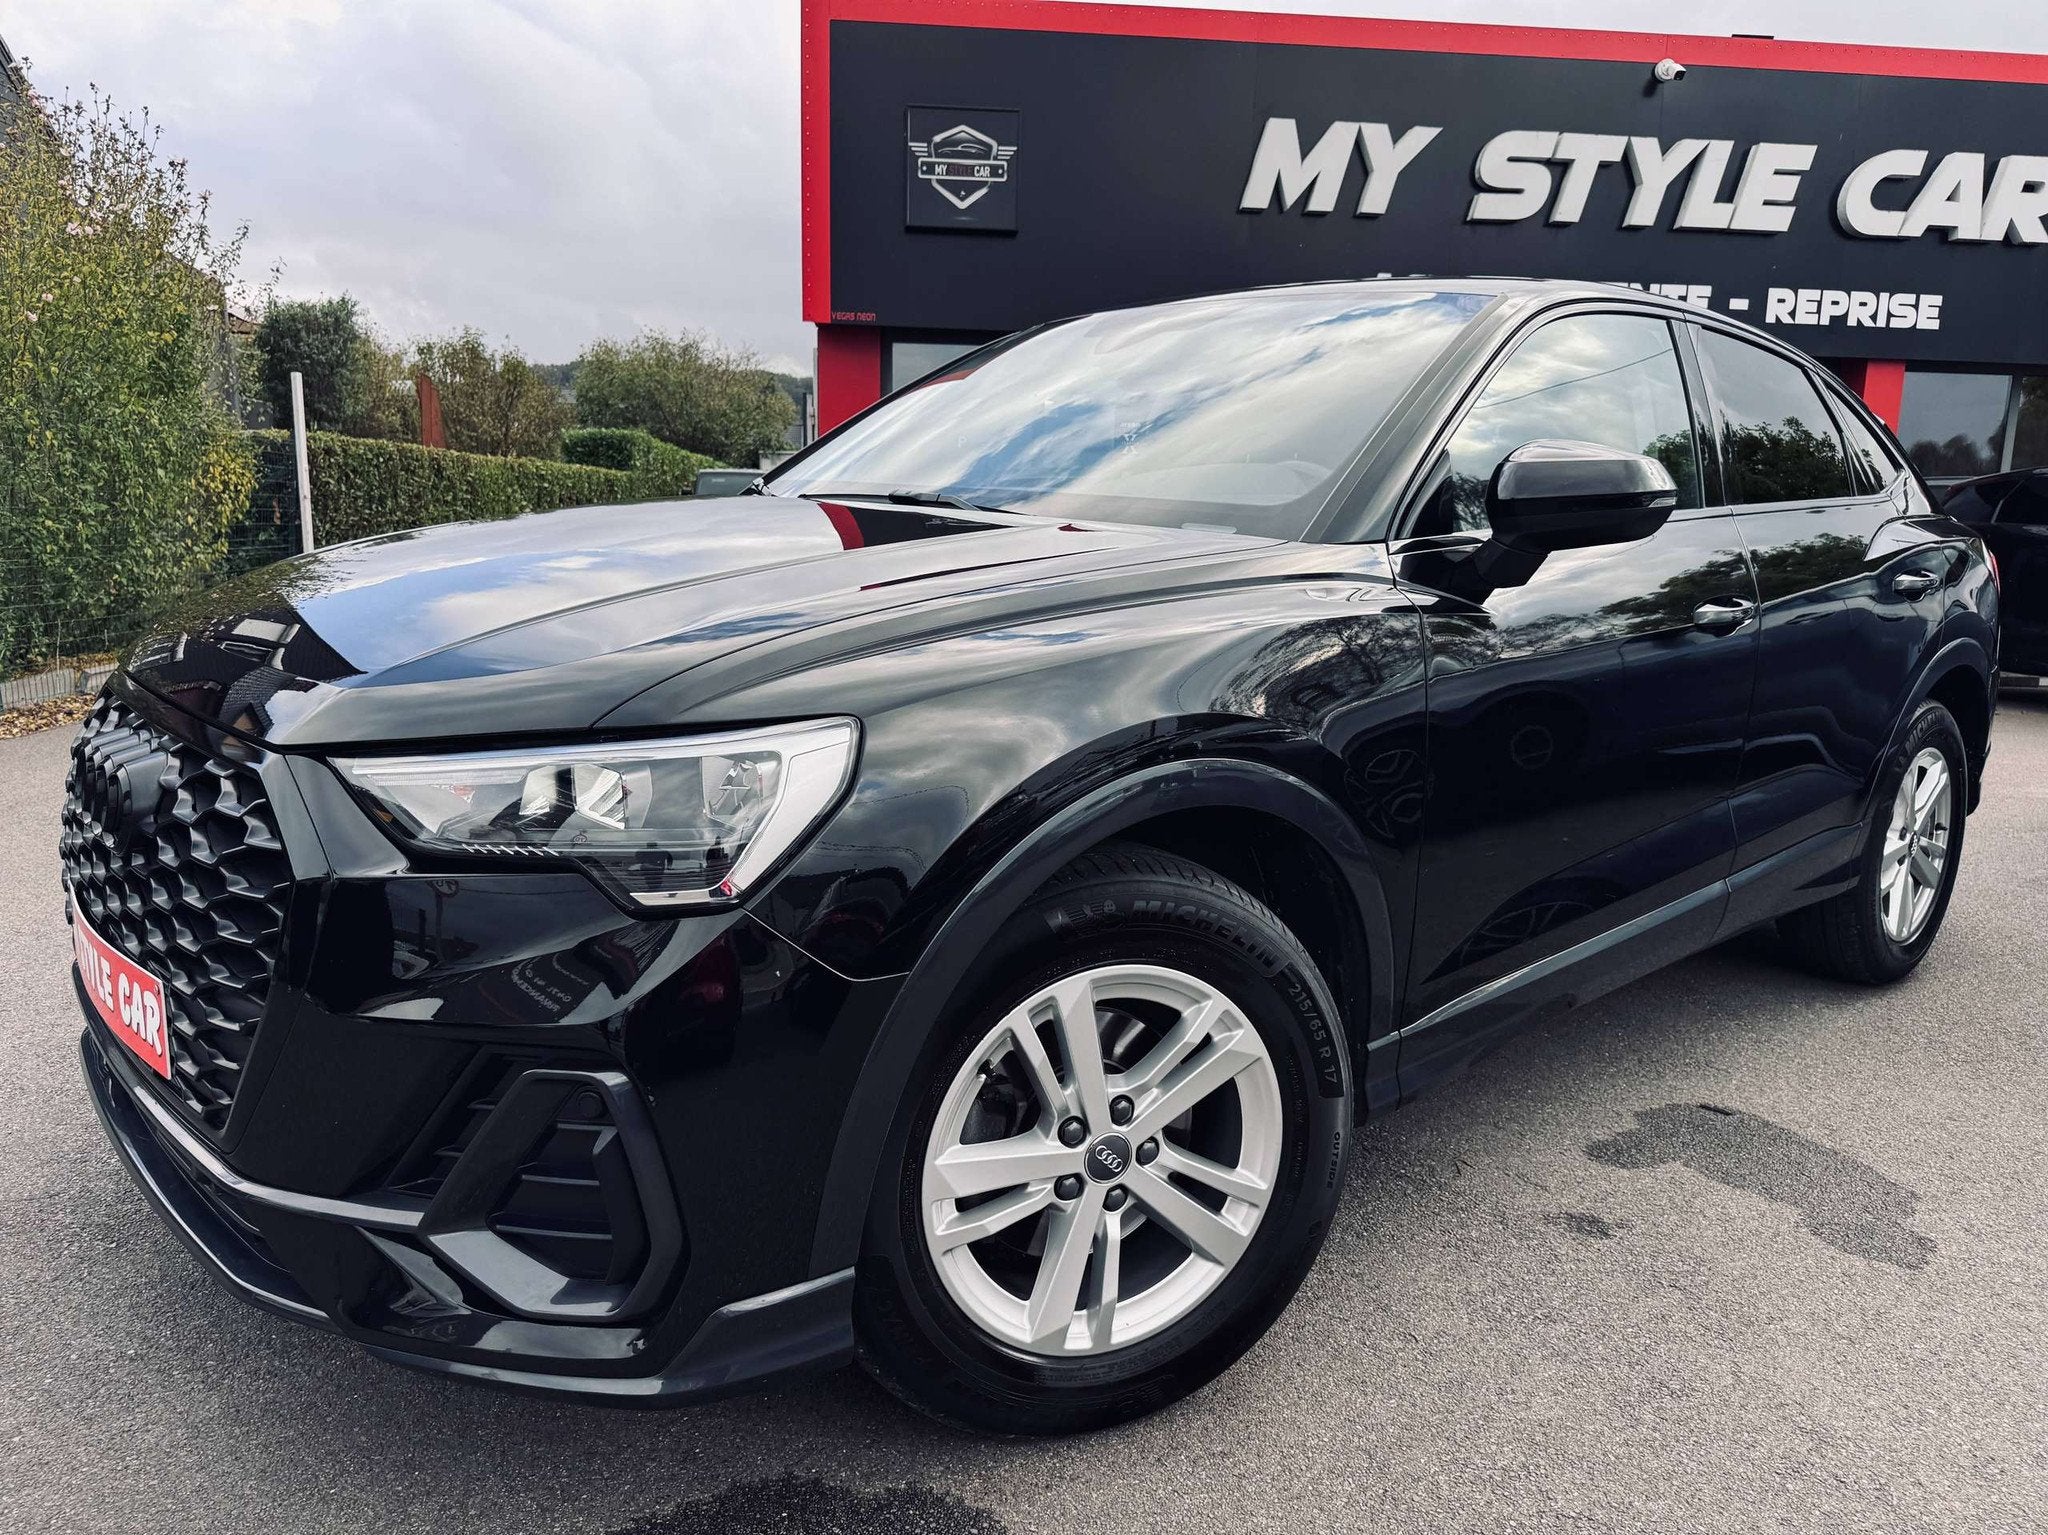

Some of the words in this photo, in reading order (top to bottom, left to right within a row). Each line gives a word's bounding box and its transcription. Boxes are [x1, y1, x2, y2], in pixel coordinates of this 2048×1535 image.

[935, 164, 948, 175] MY
[949, 165, 972, 176] STYLE
[974, 166, 991, 178] CAR
[1238, 117, 1444, 216] MY
[1466, 129, 1818, 232] STYLE
[1836, 149, 2048, 244] CAR
[1765, 288, 1943, 329] REPRISE
[1133, 899, 1281, 967] MICHELIN
[75, 920, 114, 1012] TYLE
[118, 972, 162, 1055] CAR
[1288, 984, 1327, 1041] 215/65
[1319, 1047, 1332, 1058] R
[1325, 1065, 1338, 1083] 17
[1327, 1132, 1341, 1189] OUTSIDE
